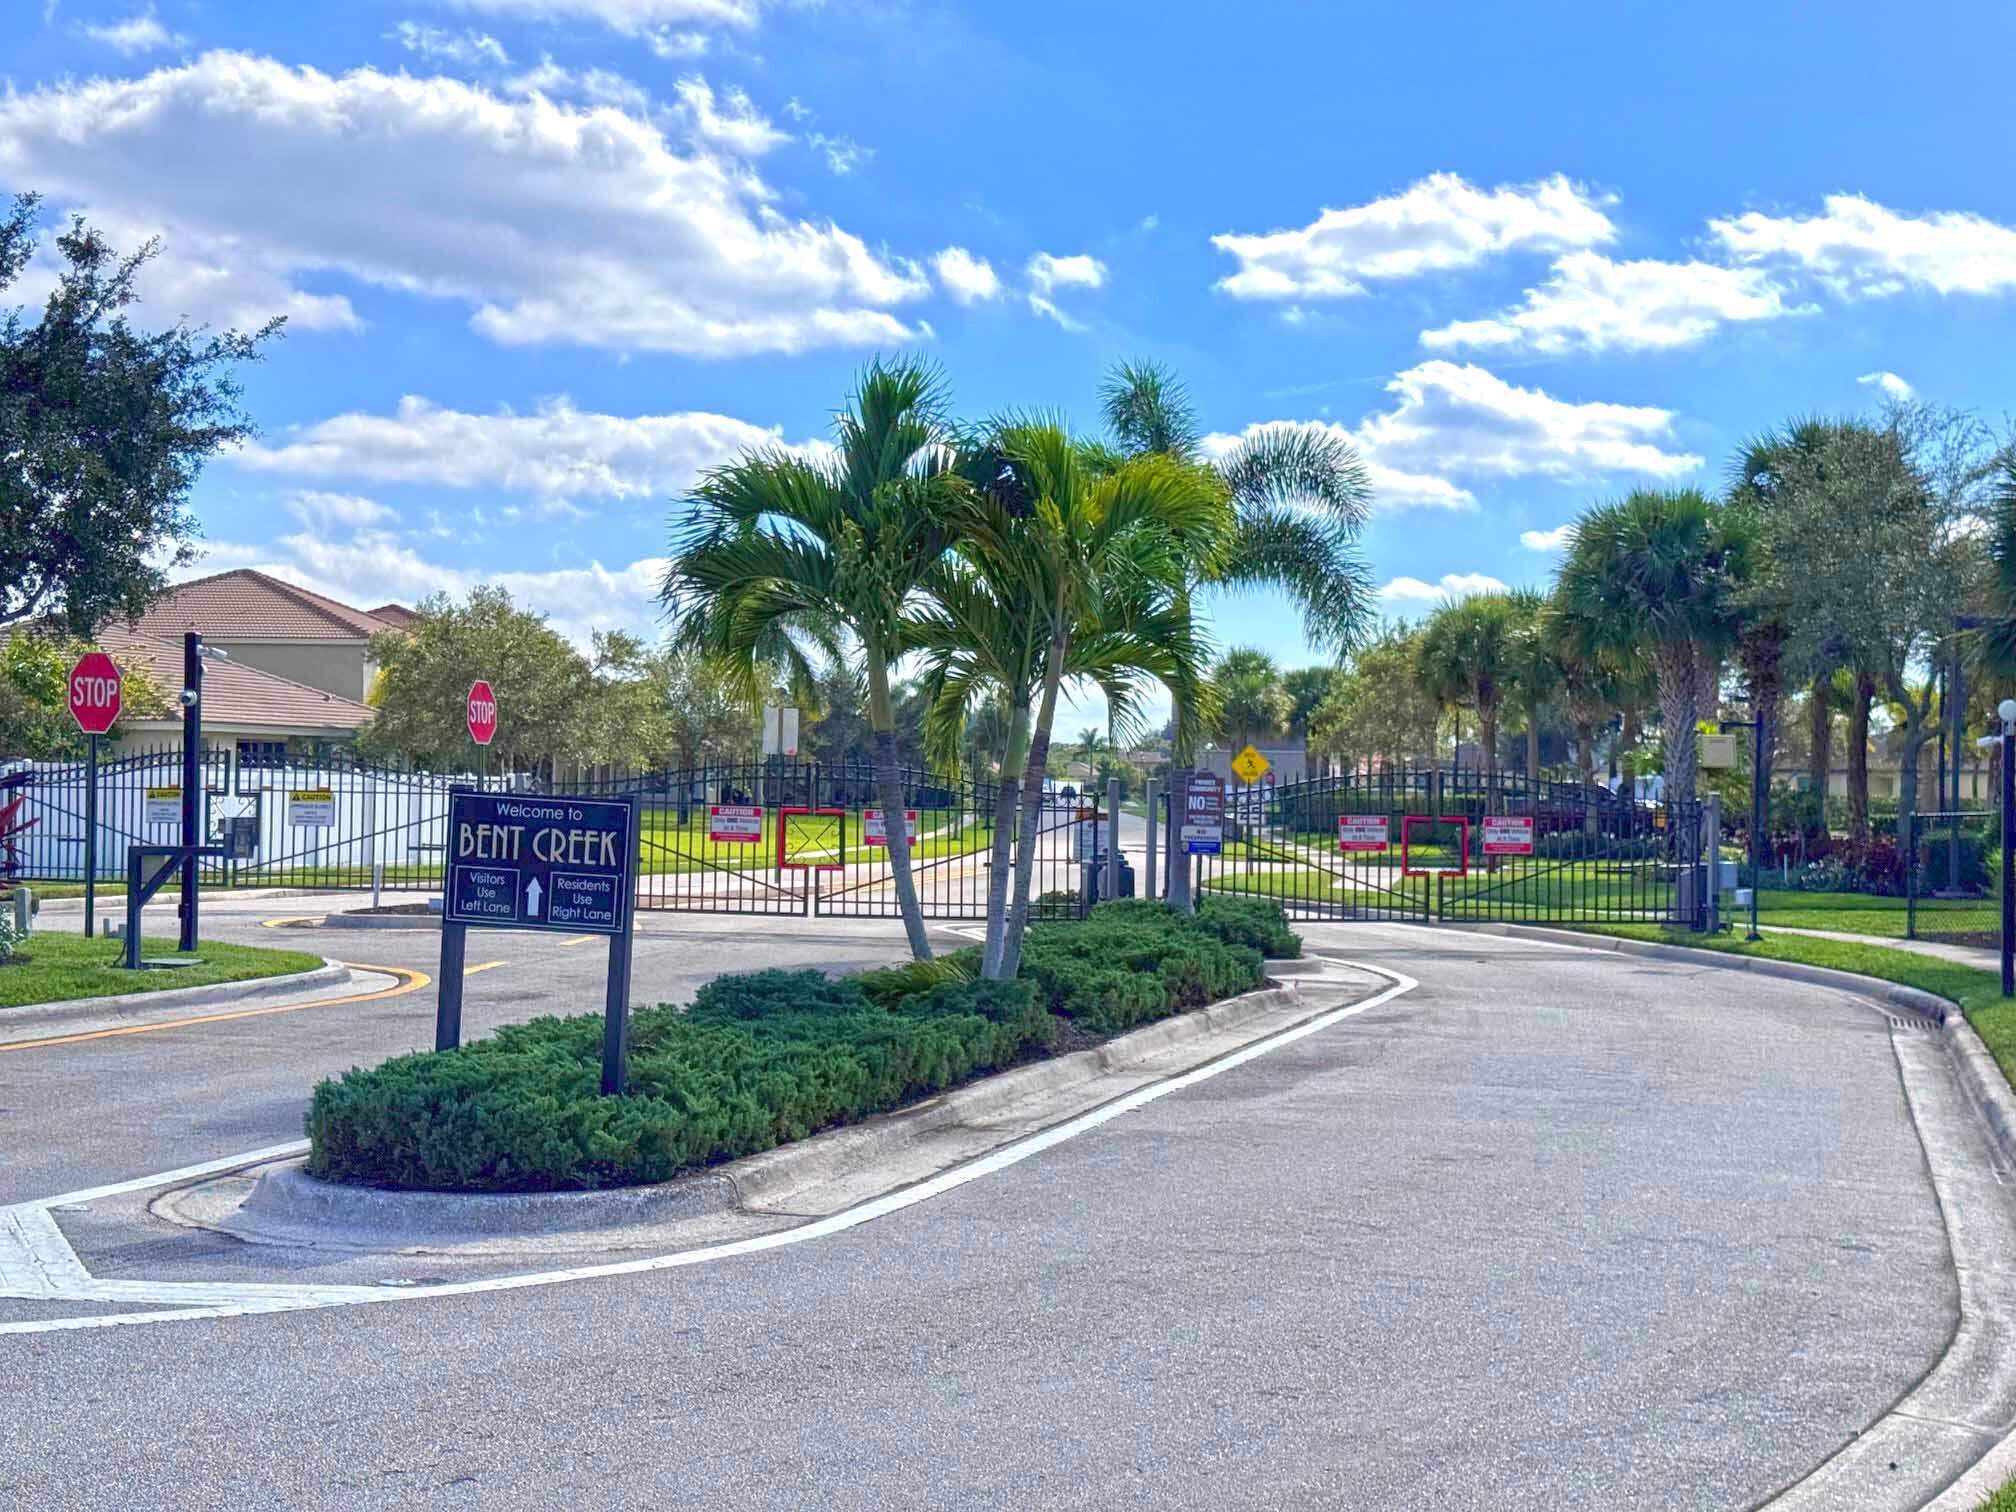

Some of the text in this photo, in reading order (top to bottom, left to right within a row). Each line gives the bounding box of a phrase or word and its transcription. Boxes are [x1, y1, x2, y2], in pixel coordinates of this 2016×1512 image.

[73, 677, 117, 707] STOP
[470, 701, 495, 724] STOP
[1188, 796, 1206, 810] NO
[497, 803, 583, 821] Welcome to
[719, 808, 754, 816] CAUTION
[459, 823, 617, 866] BENT CREEK
[470, 872, 505, 885] Visitors
[558, 878, 610, 892] Residents
[477, 887, 496, 898] Use
[573, 893, 592, 905] Use
[461, 900, 510, 913] Left Lane
[552, 906, 612, 920] Right Lane
